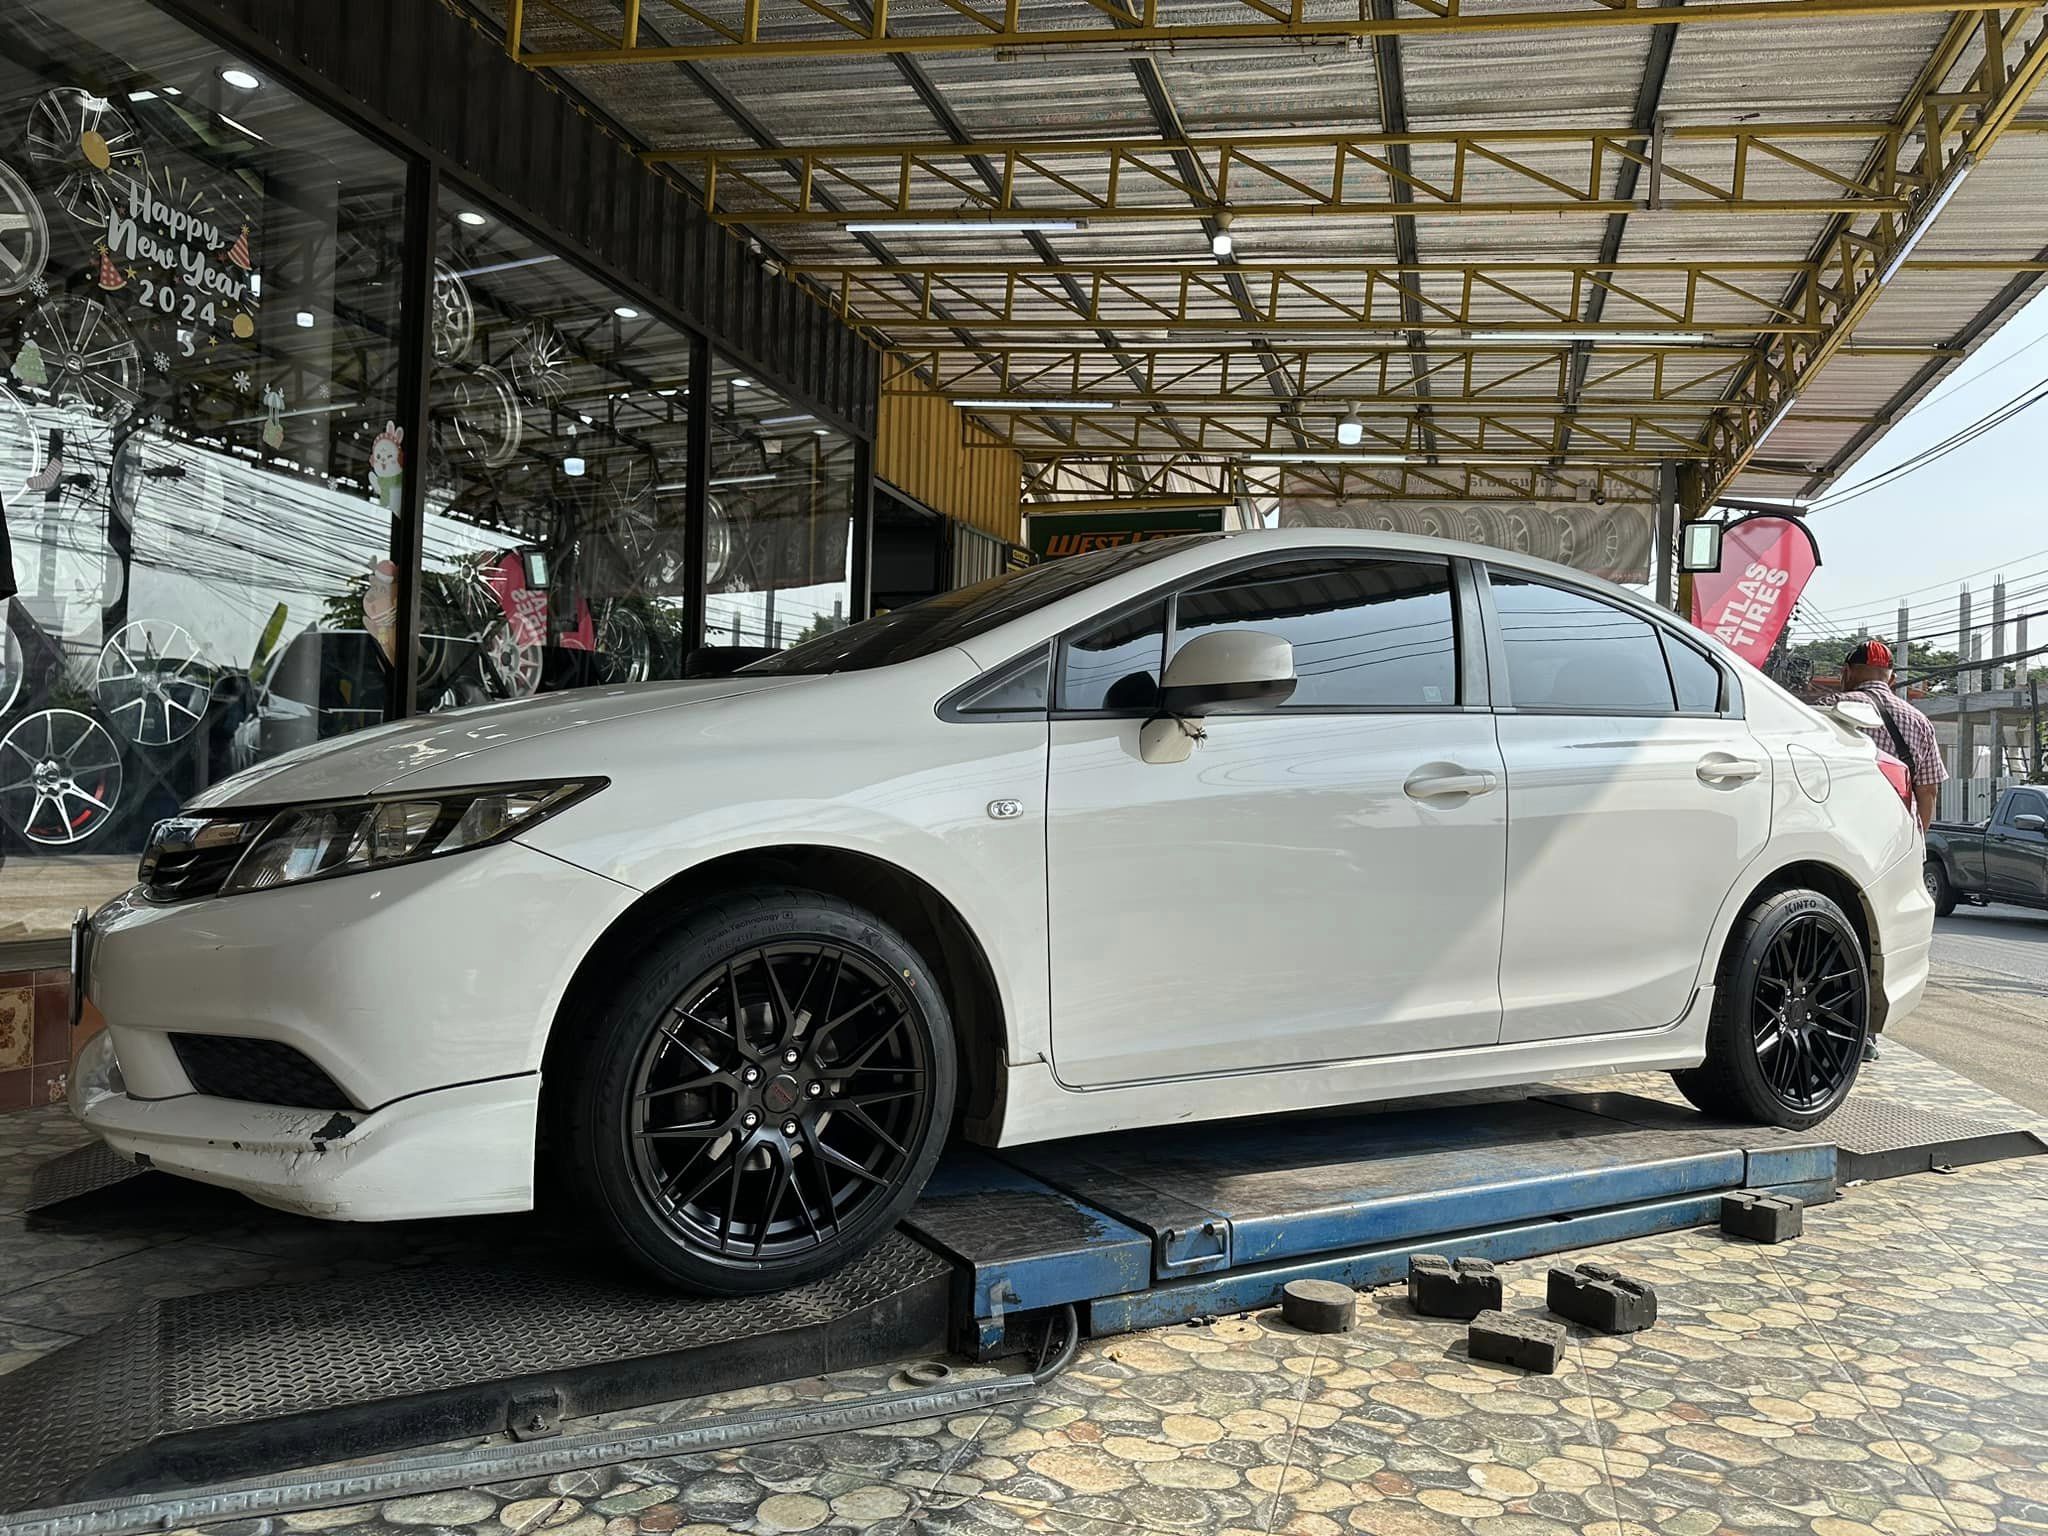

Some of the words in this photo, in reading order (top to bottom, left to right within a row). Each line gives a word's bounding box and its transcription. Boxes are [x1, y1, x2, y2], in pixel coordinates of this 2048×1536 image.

[128, 182, 225, 250] Happy
[108, 208, 178, 269] New
[180, 243, 247, 301] Year
[138, 279, 217, 327] 2024
[1046, 534, 1125, 556] WEST
[1714, 562, 1768, 645] ATLAS
[1731, 568, 1789, 646] TIRES
[703, 926, 730, 945] Japan
[731, 912, 779, 930] Technology
[1784, 900, 1817, 915] KINTO
